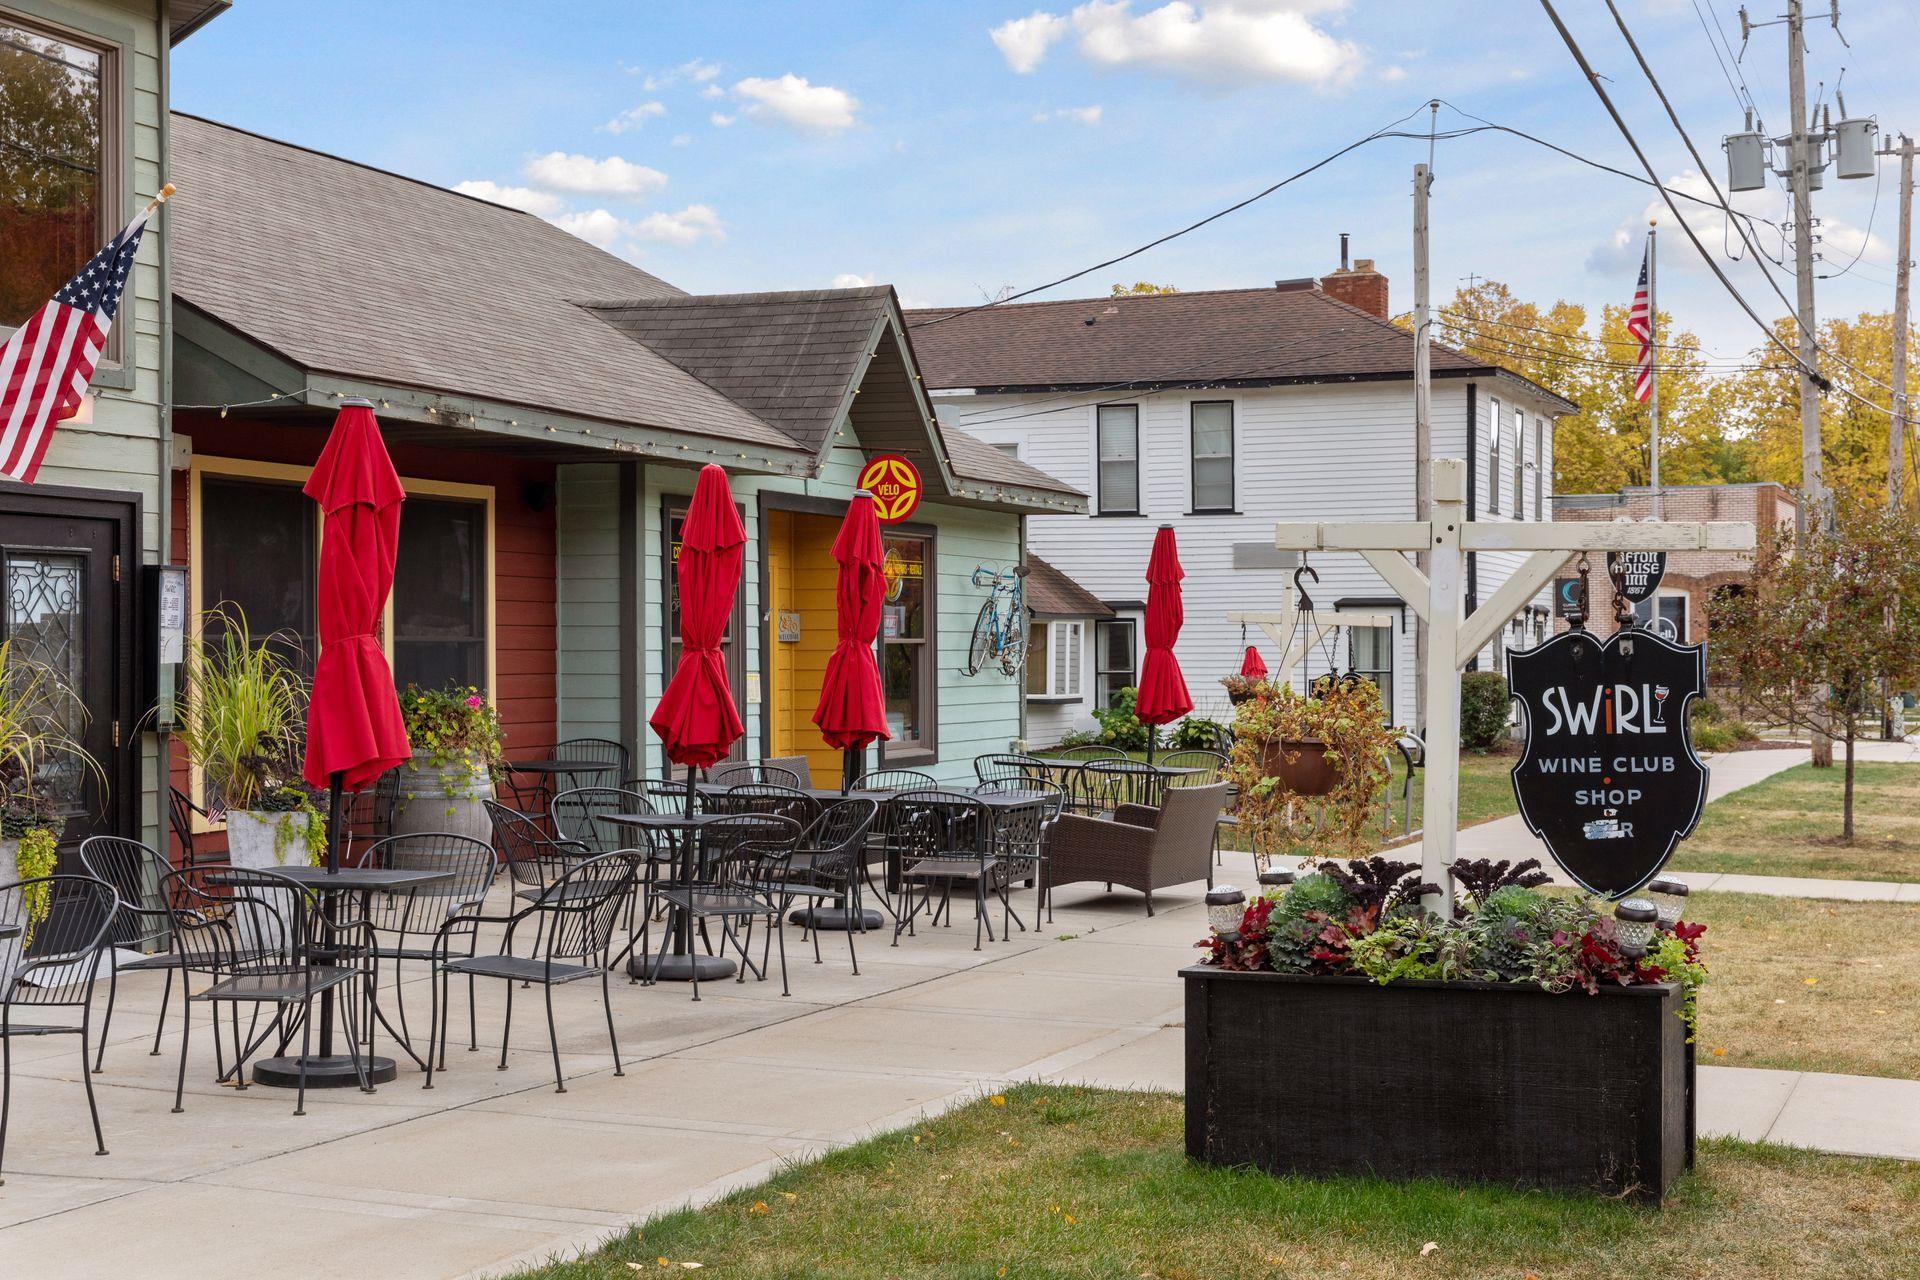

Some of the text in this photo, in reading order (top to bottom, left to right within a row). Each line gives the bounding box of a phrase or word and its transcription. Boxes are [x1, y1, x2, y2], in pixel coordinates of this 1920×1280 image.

[1538, 756, 1675, 773] WINE CLUB
[1575, 789, 1642, 805] SHOP
